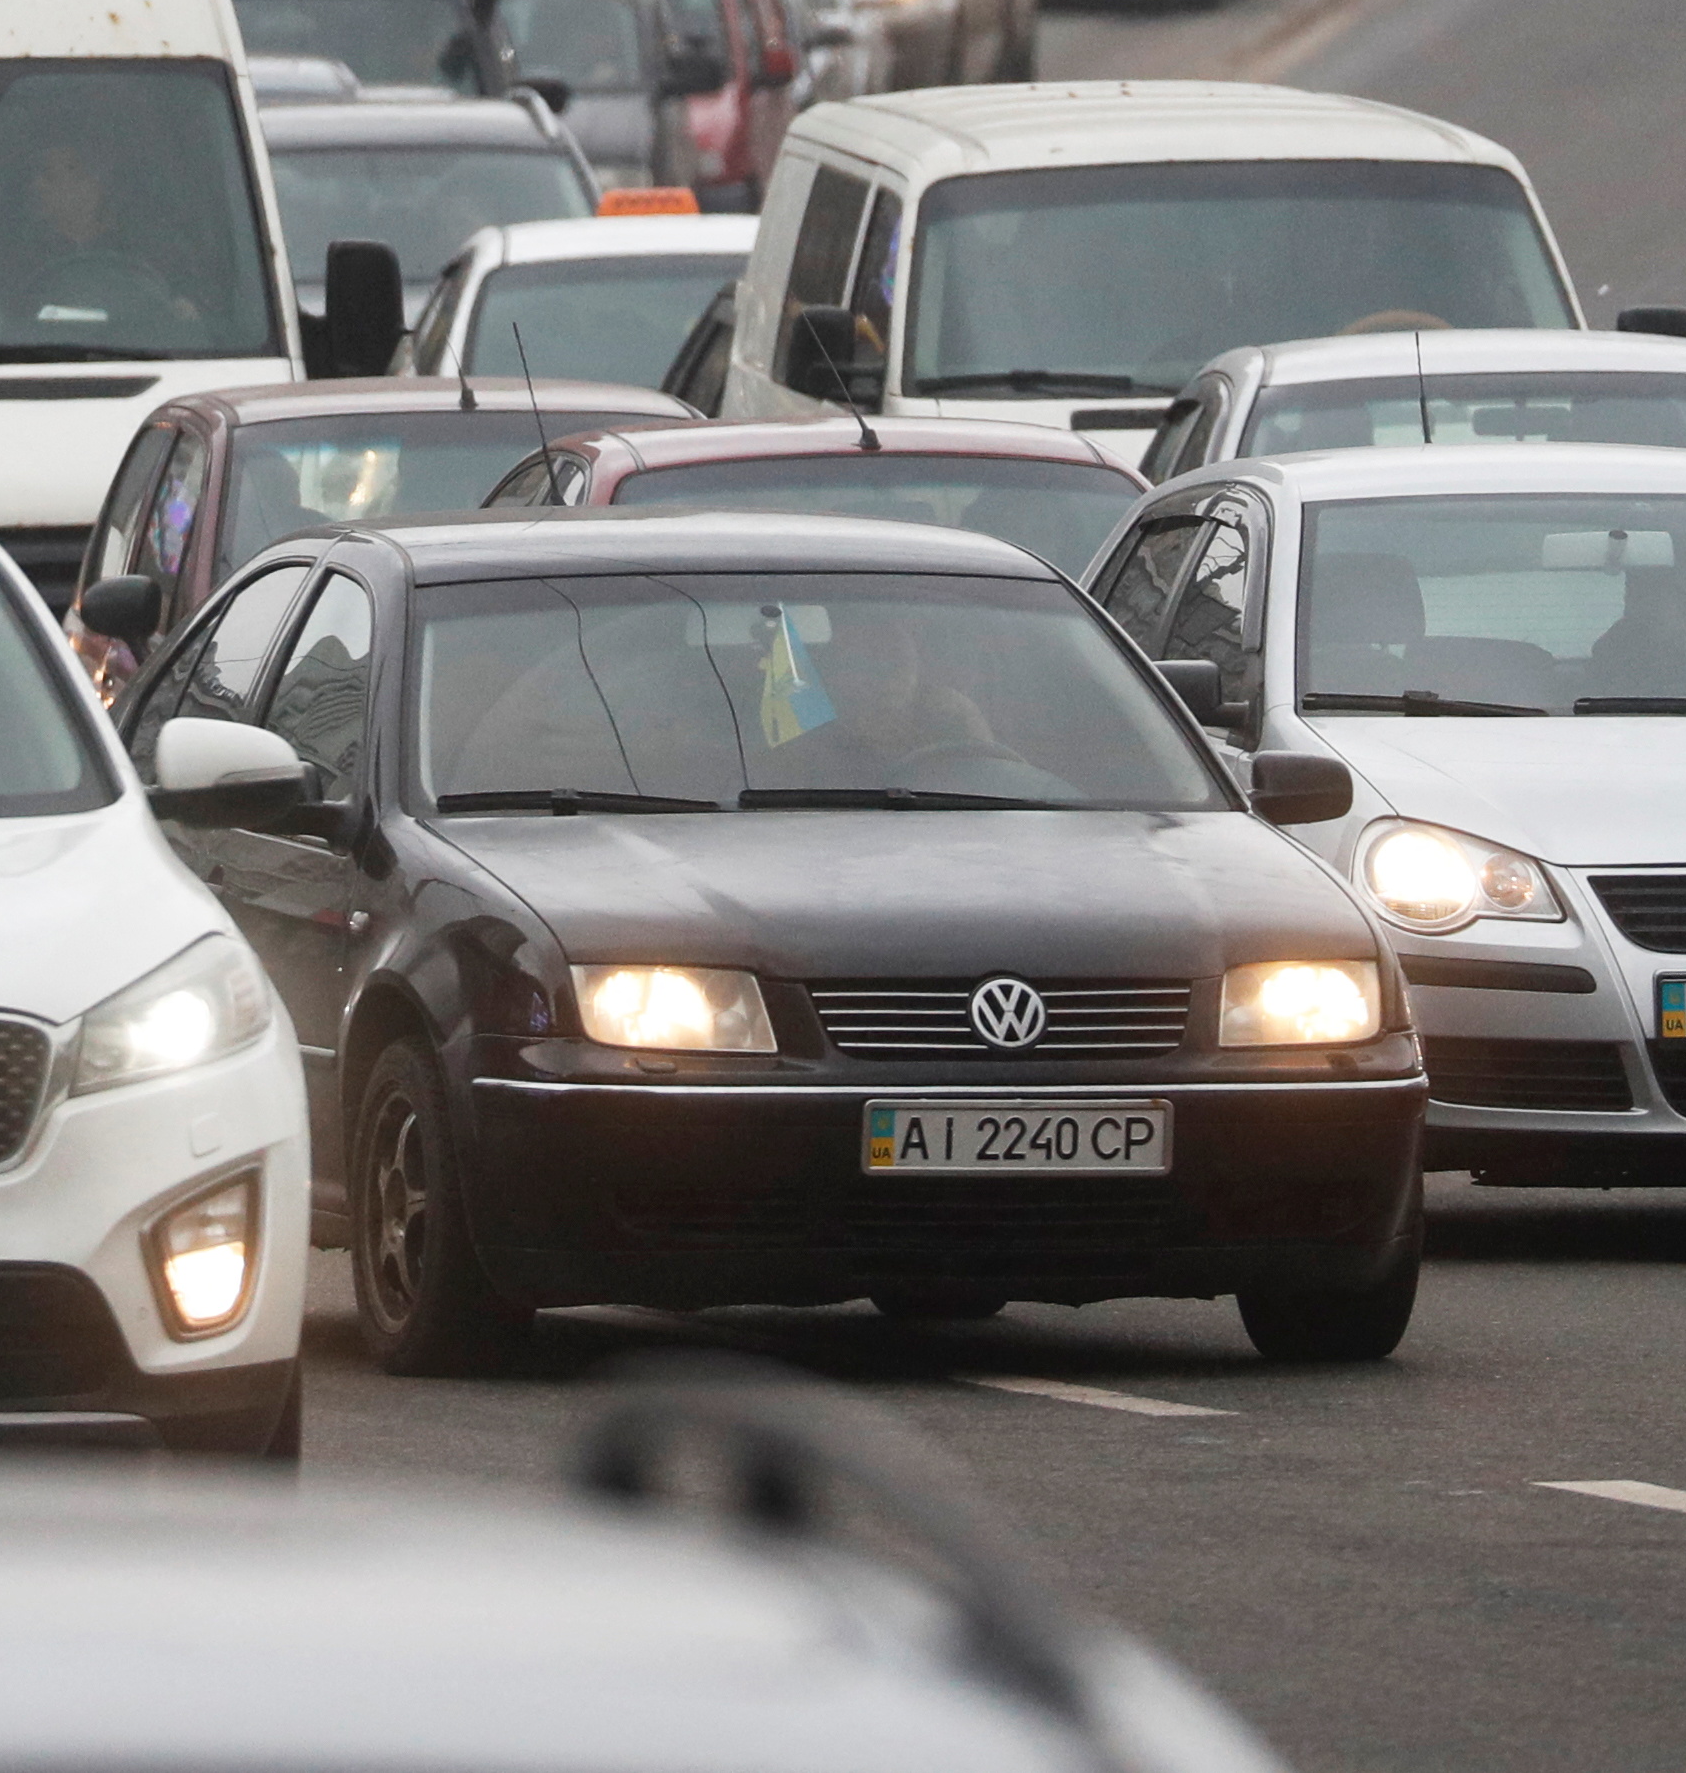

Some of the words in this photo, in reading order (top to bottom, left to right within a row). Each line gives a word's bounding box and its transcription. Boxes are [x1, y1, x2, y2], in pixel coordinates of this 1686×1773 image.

[900, 1116, 955, 1161] AI
[976, 1116, 1080, 1161] 2240
[1091, 1116, 1155, 1161] CP
[872, 1147, 891, 1159] UA
